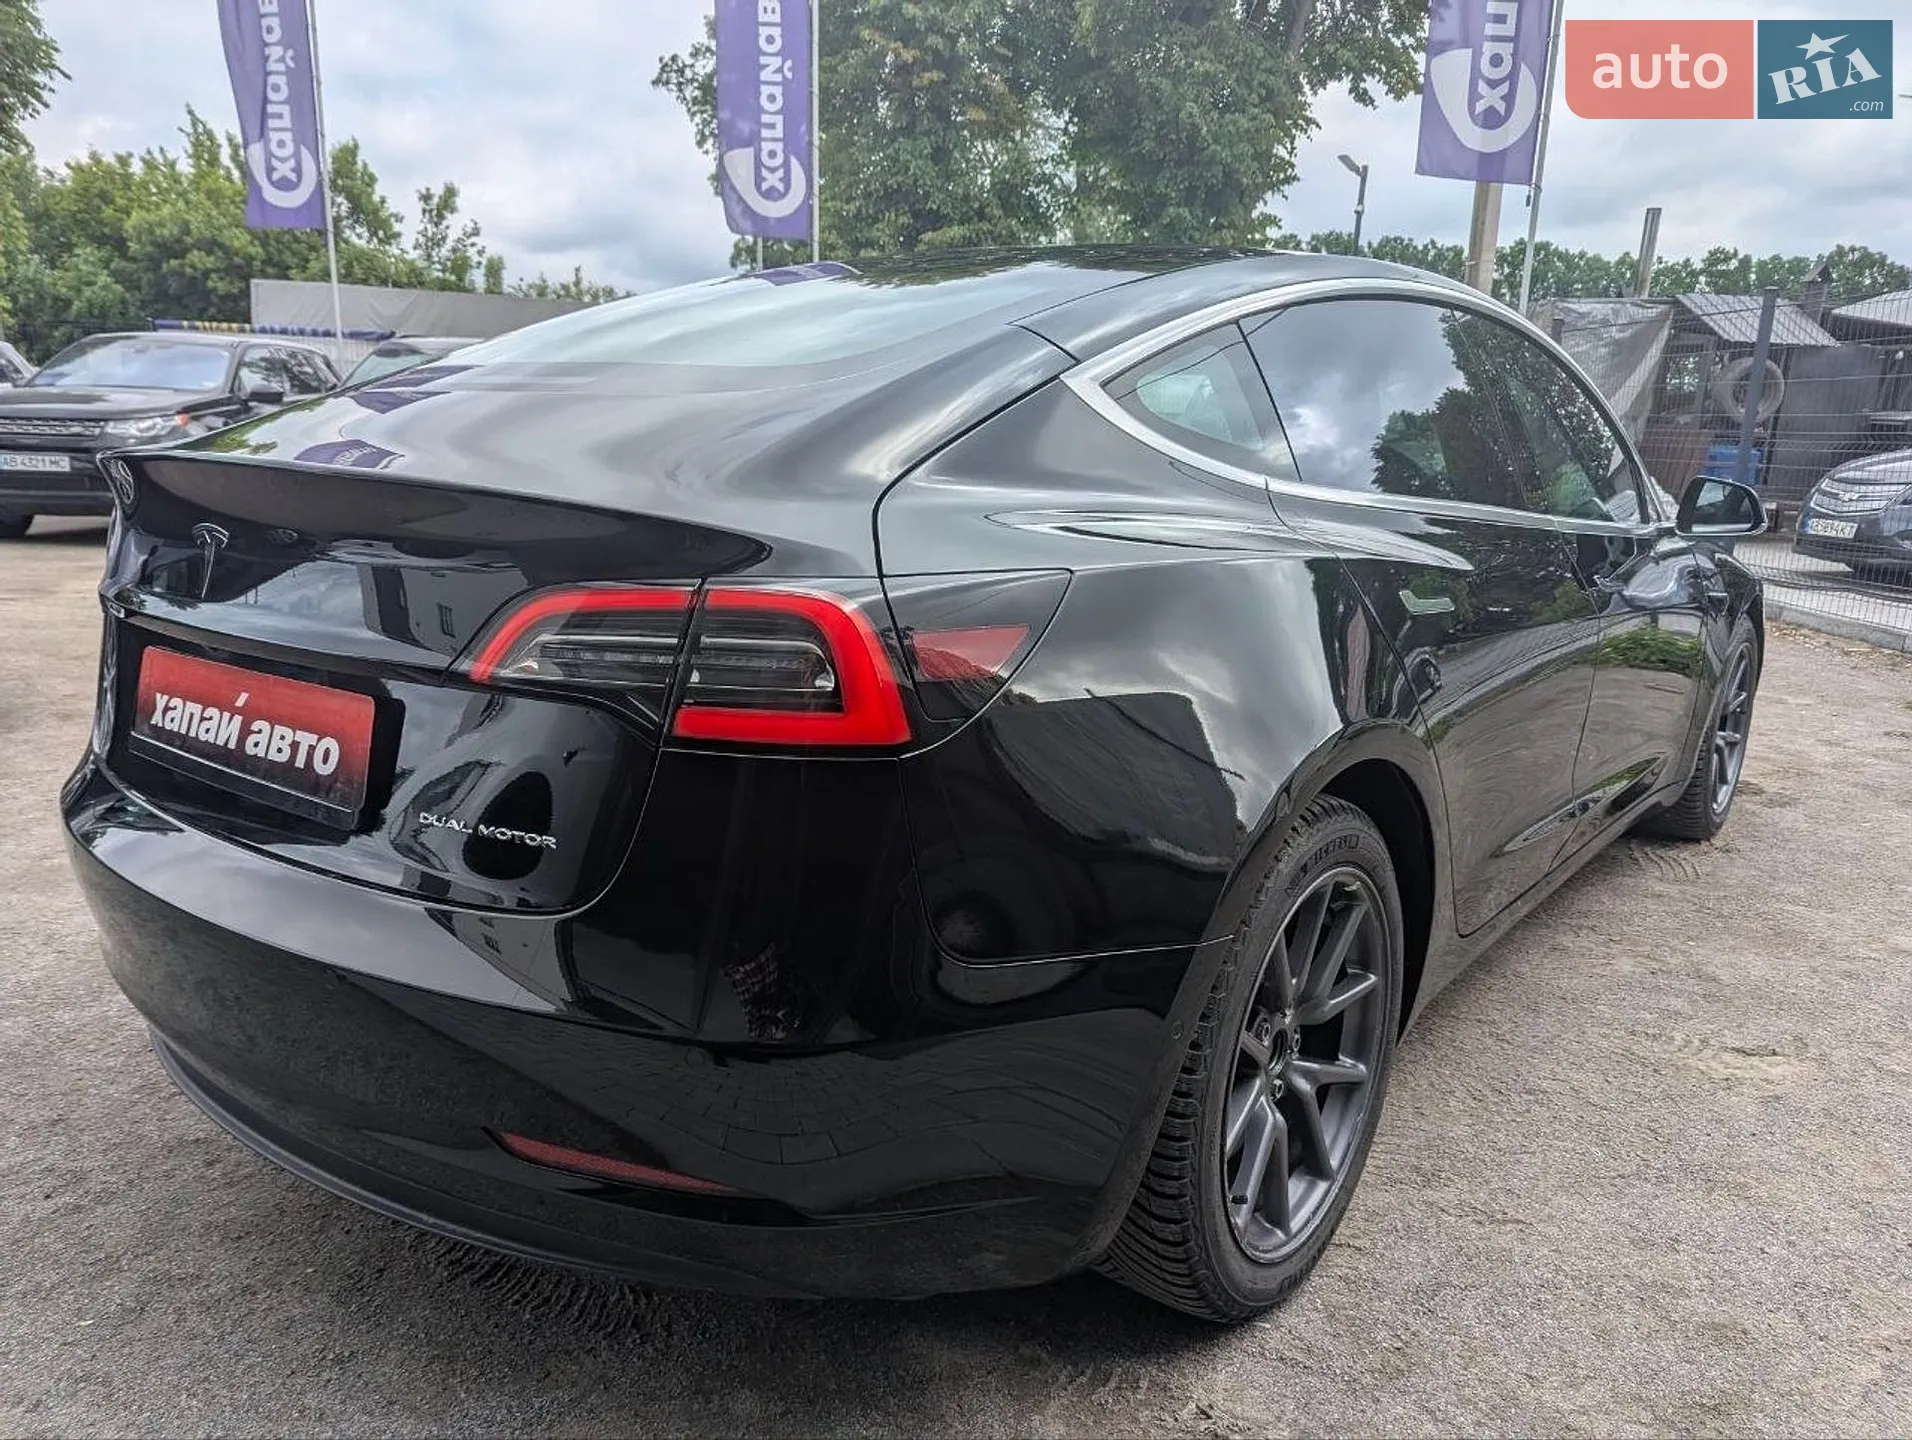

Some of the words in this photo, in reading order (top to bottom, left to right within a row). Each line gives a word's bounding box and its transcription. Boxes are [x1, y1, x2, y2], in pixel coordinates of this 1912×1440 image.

[245, 719, 340, 775] авто
[419, 812, 473, 834] DUAL
[478, 824, 557, 849] MOTOR
